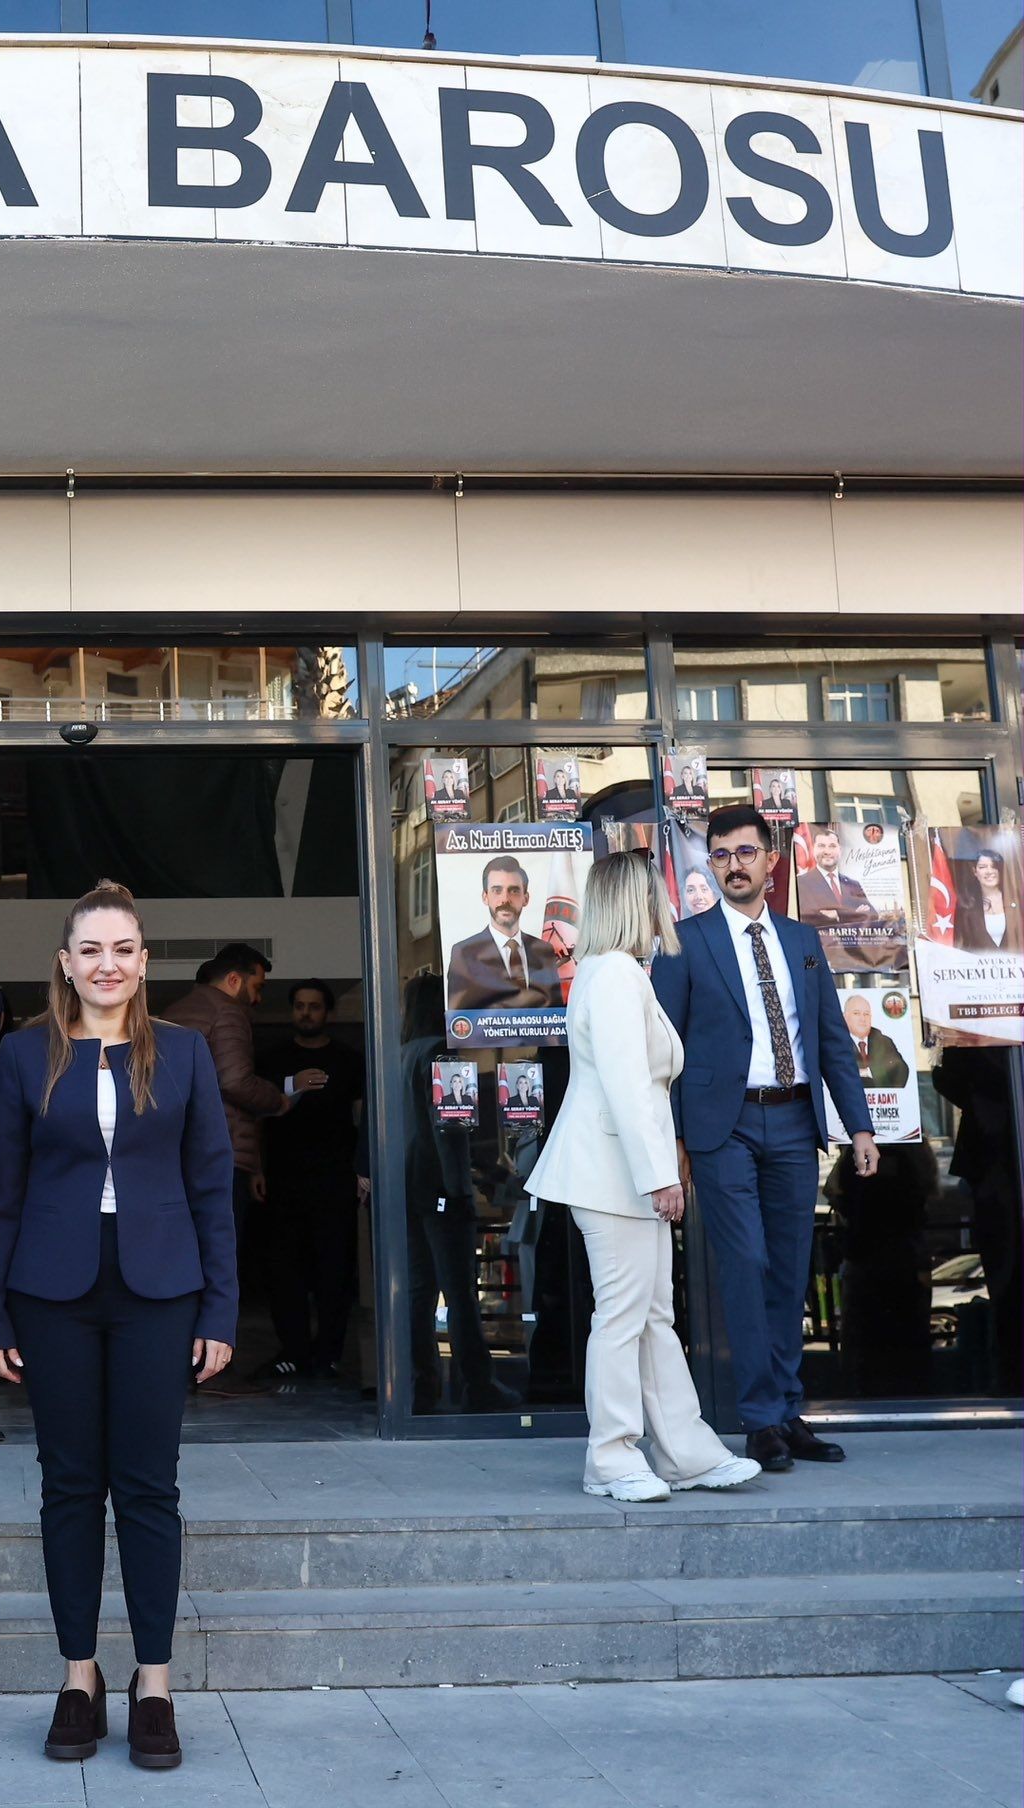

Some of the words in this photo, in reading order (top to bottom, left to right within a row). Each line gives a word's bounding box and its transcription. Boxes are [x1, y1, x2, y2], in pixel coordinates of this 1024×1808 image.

[146, 72, 957, 258] BAROSU
[446, 830, 467, 849] Av.
[469, 829, 500, 849] Nuri
[503, 828, 545, 848] Erman
[549, 828, 583, 851] ATEŞ
[828, 927, 857, 937] BARIŞ
[858, 927, 893, 936] YILMAZ
[977, 957, 1017, 966] AVUKAT
[933, 968, 986, 983] ŞEBNEM
[957, 1007, 977, 1016] TBB
[980, 1006, 1019, 1015] DELEGE
[477, 1015, 511, 1026] ANTALYA
[512, 1016, 541, 1025] BAROSU
[483, 1026, 517, 1037] YÖNETİM
[519, 1028, 549, 1036] KURULU
[877, 1093, 898, 1104] ADAYI
[875, 1105, 899, 1120] ŞİMŞEK
